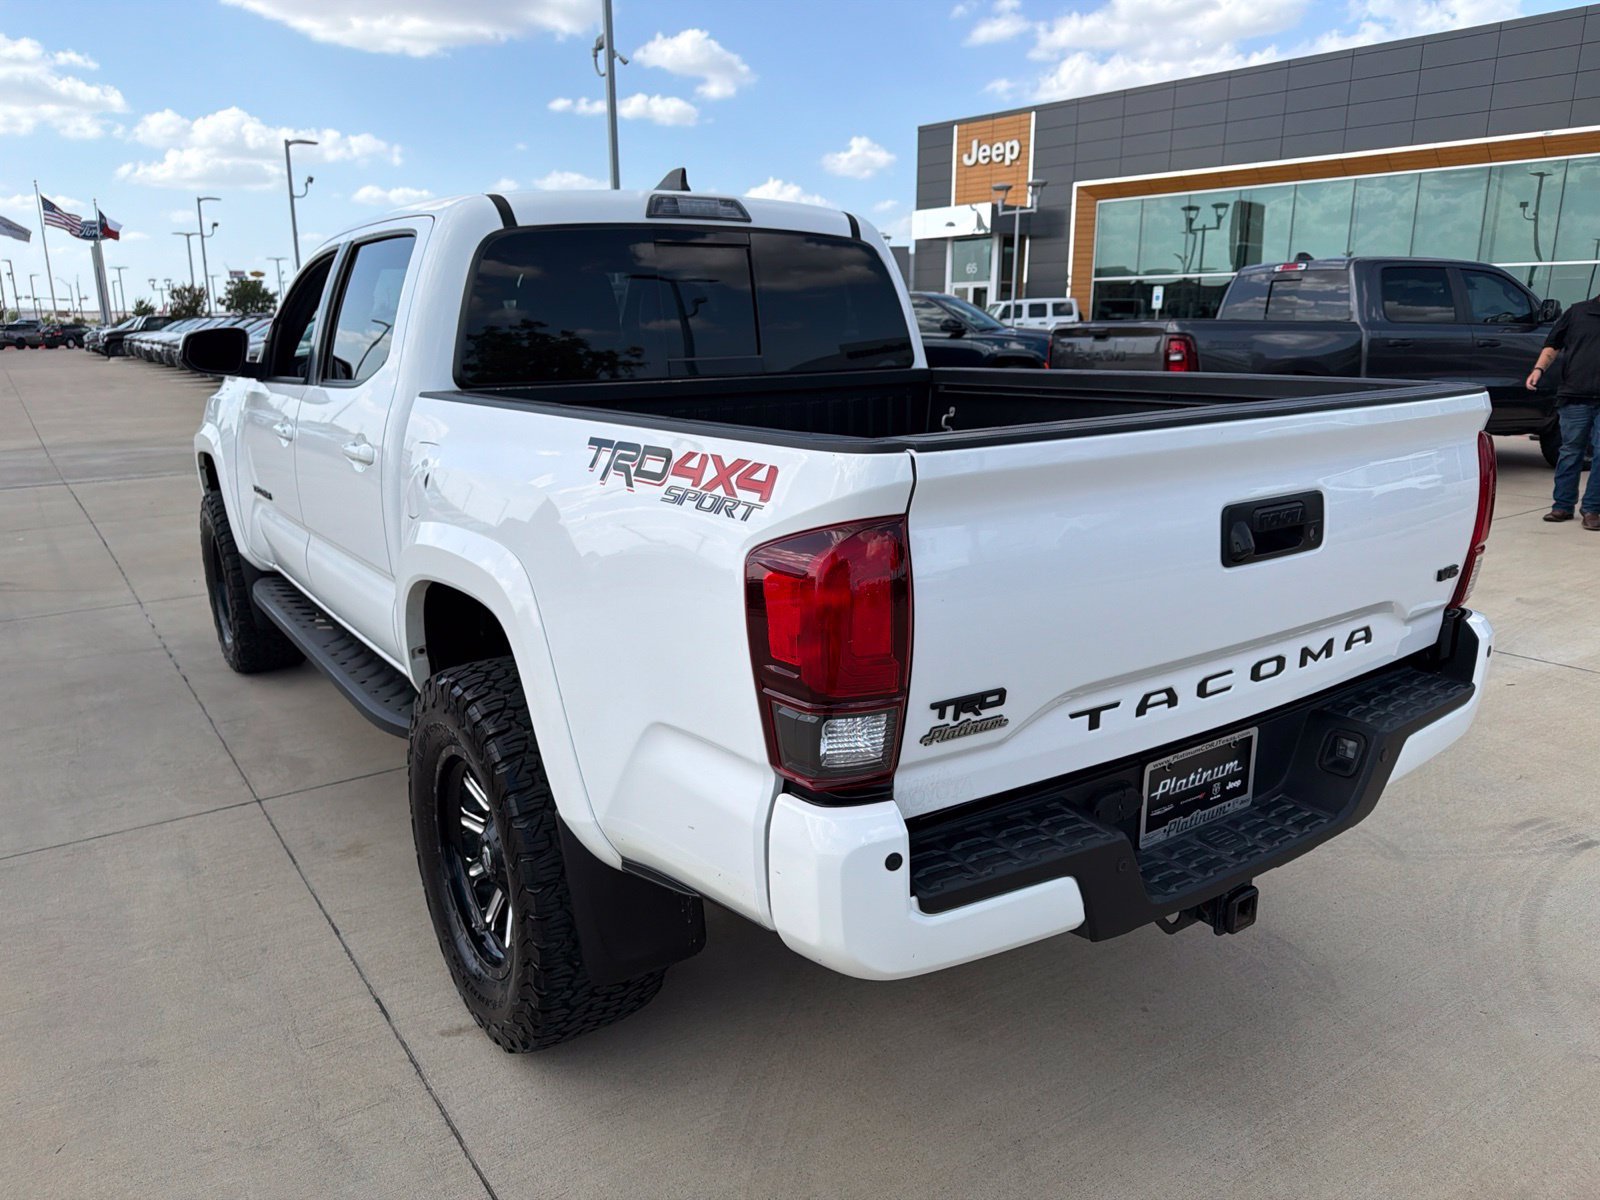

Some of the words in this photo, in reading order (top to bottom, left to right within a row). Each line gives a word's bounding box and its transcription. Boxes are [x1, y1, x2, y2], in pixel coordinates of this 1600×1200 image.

[962, 139, 1020, 167] Jeep
[966, 262, 978, 274] 65
[587, 436, 673, 493] TRD
[660, 485, 765, 522] SPORT
[1068, 625, 1373, 732] TACOMA
[929, 687, 1007, 721] TRD
[919, 714, 1009, 746] Platinum
[1150, 760, 1243, 800] Platinum
[1226, 779, 1242, 790] Jeep
[1168, 805, 1227, 836] Platinum
